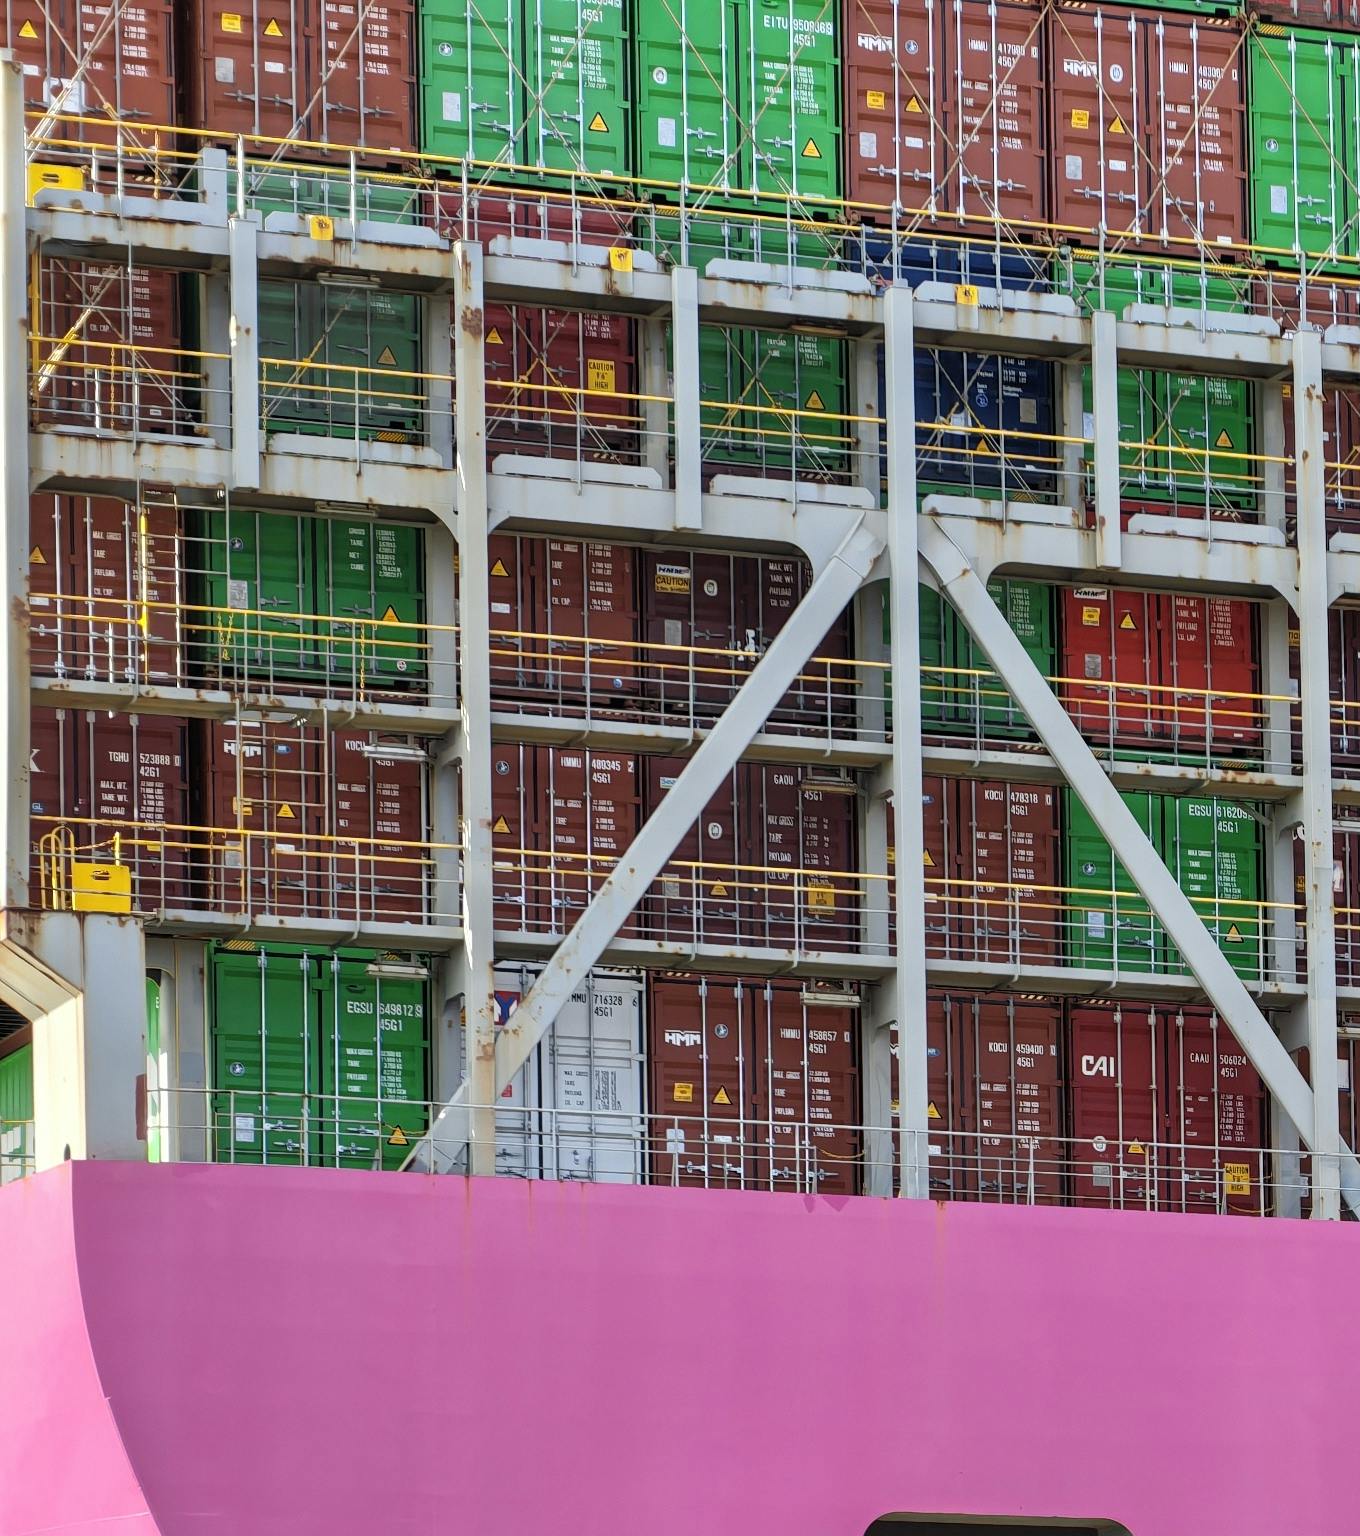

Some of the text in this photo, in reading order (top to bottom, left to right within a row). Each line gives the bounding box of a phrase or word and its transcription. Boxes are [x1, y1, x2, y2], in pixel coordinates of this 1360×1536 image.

[764, 15, 788, 28] EITU
[589, 362, 614, 371] CAUTION
[595, 381, 608, 389] HIGH
[656, 576, 689, 586] CAUTION
[109, 752, 129, 762] TGHU
[174, 755, 181, 766] 0
[140, 767, 159, 777] 42G1
[628, 761, 634, 772] 2
[593, 773, 611, 784] 45G1
[985, 790, 1003, 800] KOCU
[1045, 795, 1051, 805] 0
[101, 806, 124, 815] PAYLOAD
[1011, 805, 1028, 815] 45G1
[1189, 804, 1211, 817] EGSU
[1218, 822, 1238, 833] 45G1
[769, 853, 791, 862] PAYLOAD
[595, 994, 637, 1007] 716328 6
[347, 1002, 373, 1014] EGSU
[595, 1007, 613, 1017] 45G1
[380, 1019, 402, 1031] 45G1
[665, 1029, 701, 1046] HMM
[780, 1028, 800, 1039] HMMU
[844, 1032, 849, 1042] 0
[809, 1043, 826, 1054] 45G1
[989, 1043, 1007, 1053] KOCU
[1016, 1044, 1043, 1054] 459400
[1017, 1057, 1034, 1068] 45G1
[1190, 1053, 1246, 1065] CAAU 506024
[1082, 1054, 1114, 1078] CAI
[1221, 1066, 1238, 1077] 45G1
[1225, 1166, 1248, 1174] CAUTION
